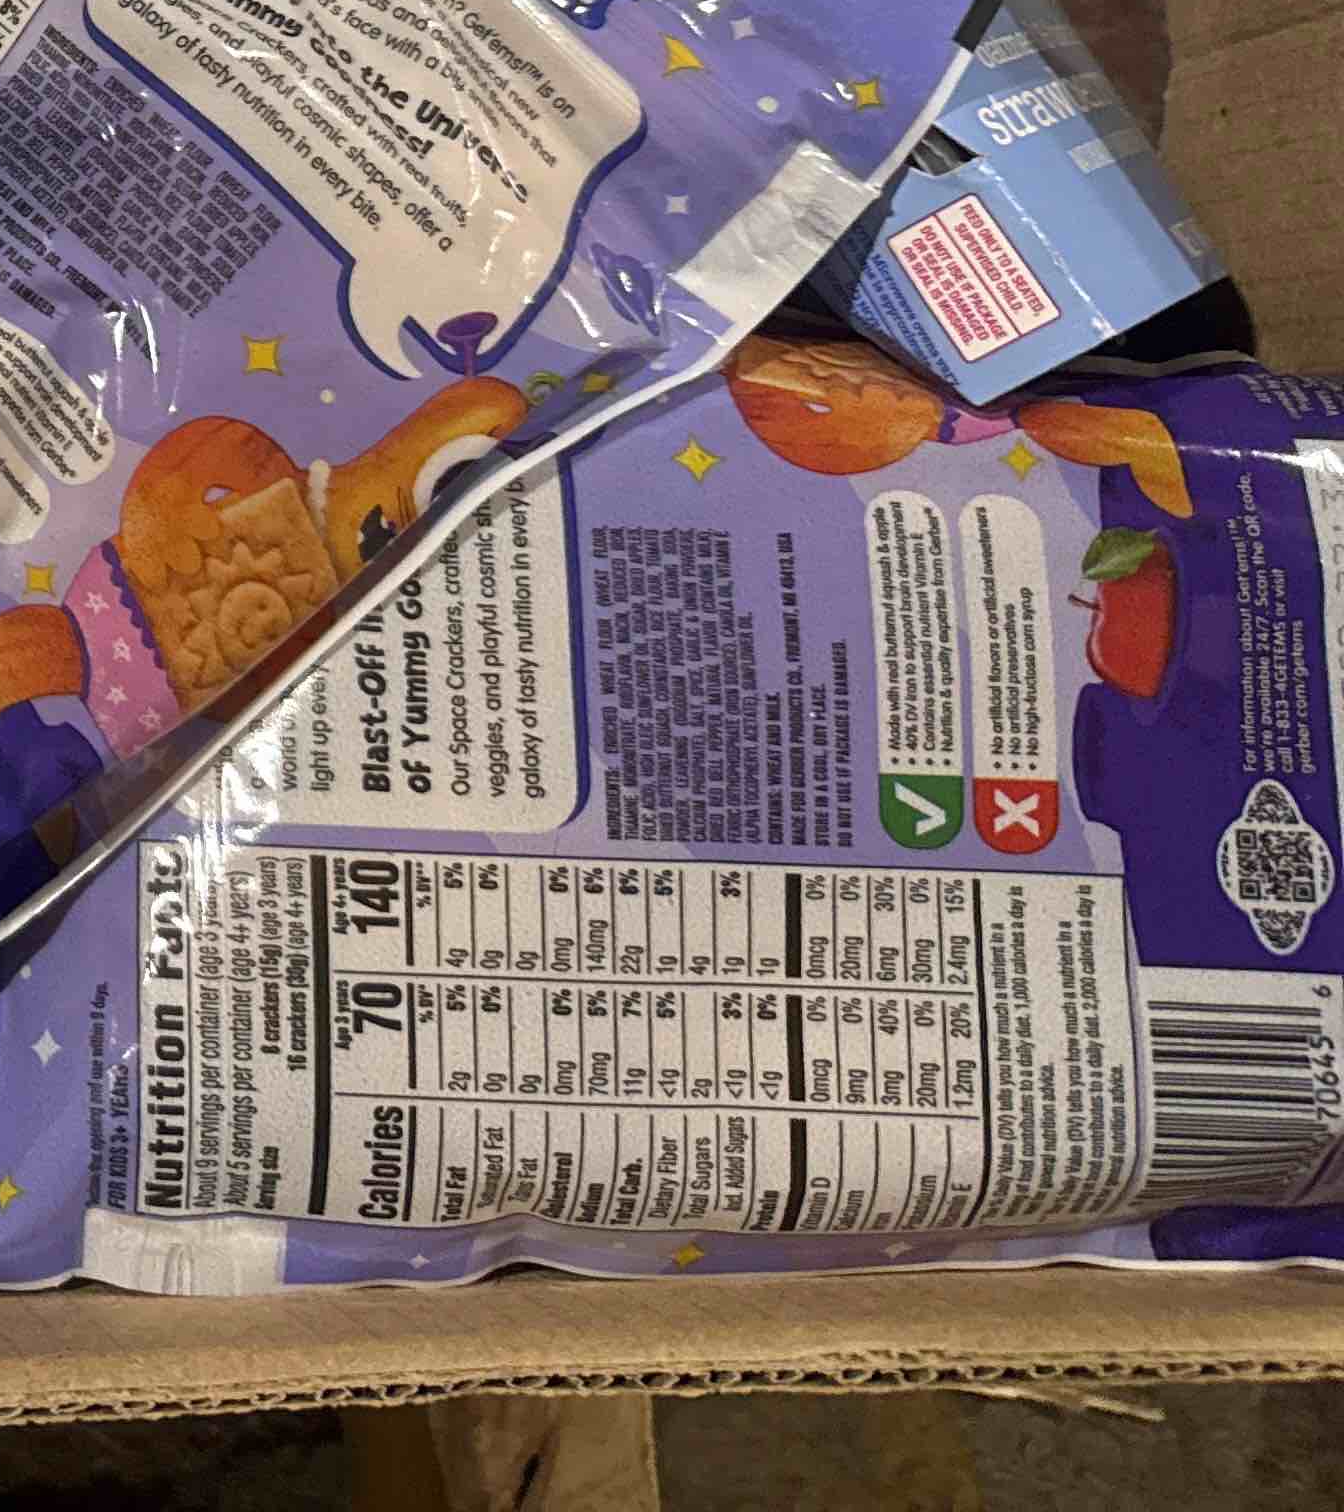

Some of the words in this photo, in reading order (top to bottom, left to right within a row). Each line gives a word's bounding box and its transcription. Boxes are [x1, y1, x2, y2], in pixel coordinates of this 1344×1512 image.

[175, 33, 201, 60] of
[193, 47, 233, 89] tasty
[231, 81, 296, 147] nutrition
[293, 132, 312, 161] in
[311, 152, 356, 200] every
[349, 192, 384, 232] bite.
[961, 203, 984, 230] FEED
[979, 227, 1002, 252] ONLY
[954, 223, 1003, 282] SUPERVISED
[996, 279, 1024, 315] CHILD.
[997, 251, 1013, 268] TO
[1007, 265, 1019, 277] A
[1012, 274, 1046, 317] SEATED,
[354, 641, 391, 793] Blast-Off
[400, 630, 432, 744] Yummy
[401, 759, 432, 794] of
[349, 860, 400, 934] 140
[351, 982, 403, 1034] 70
[145, 1003, 186, 1208] Nutrition
[359, 1105, 404, 1220] Calories
